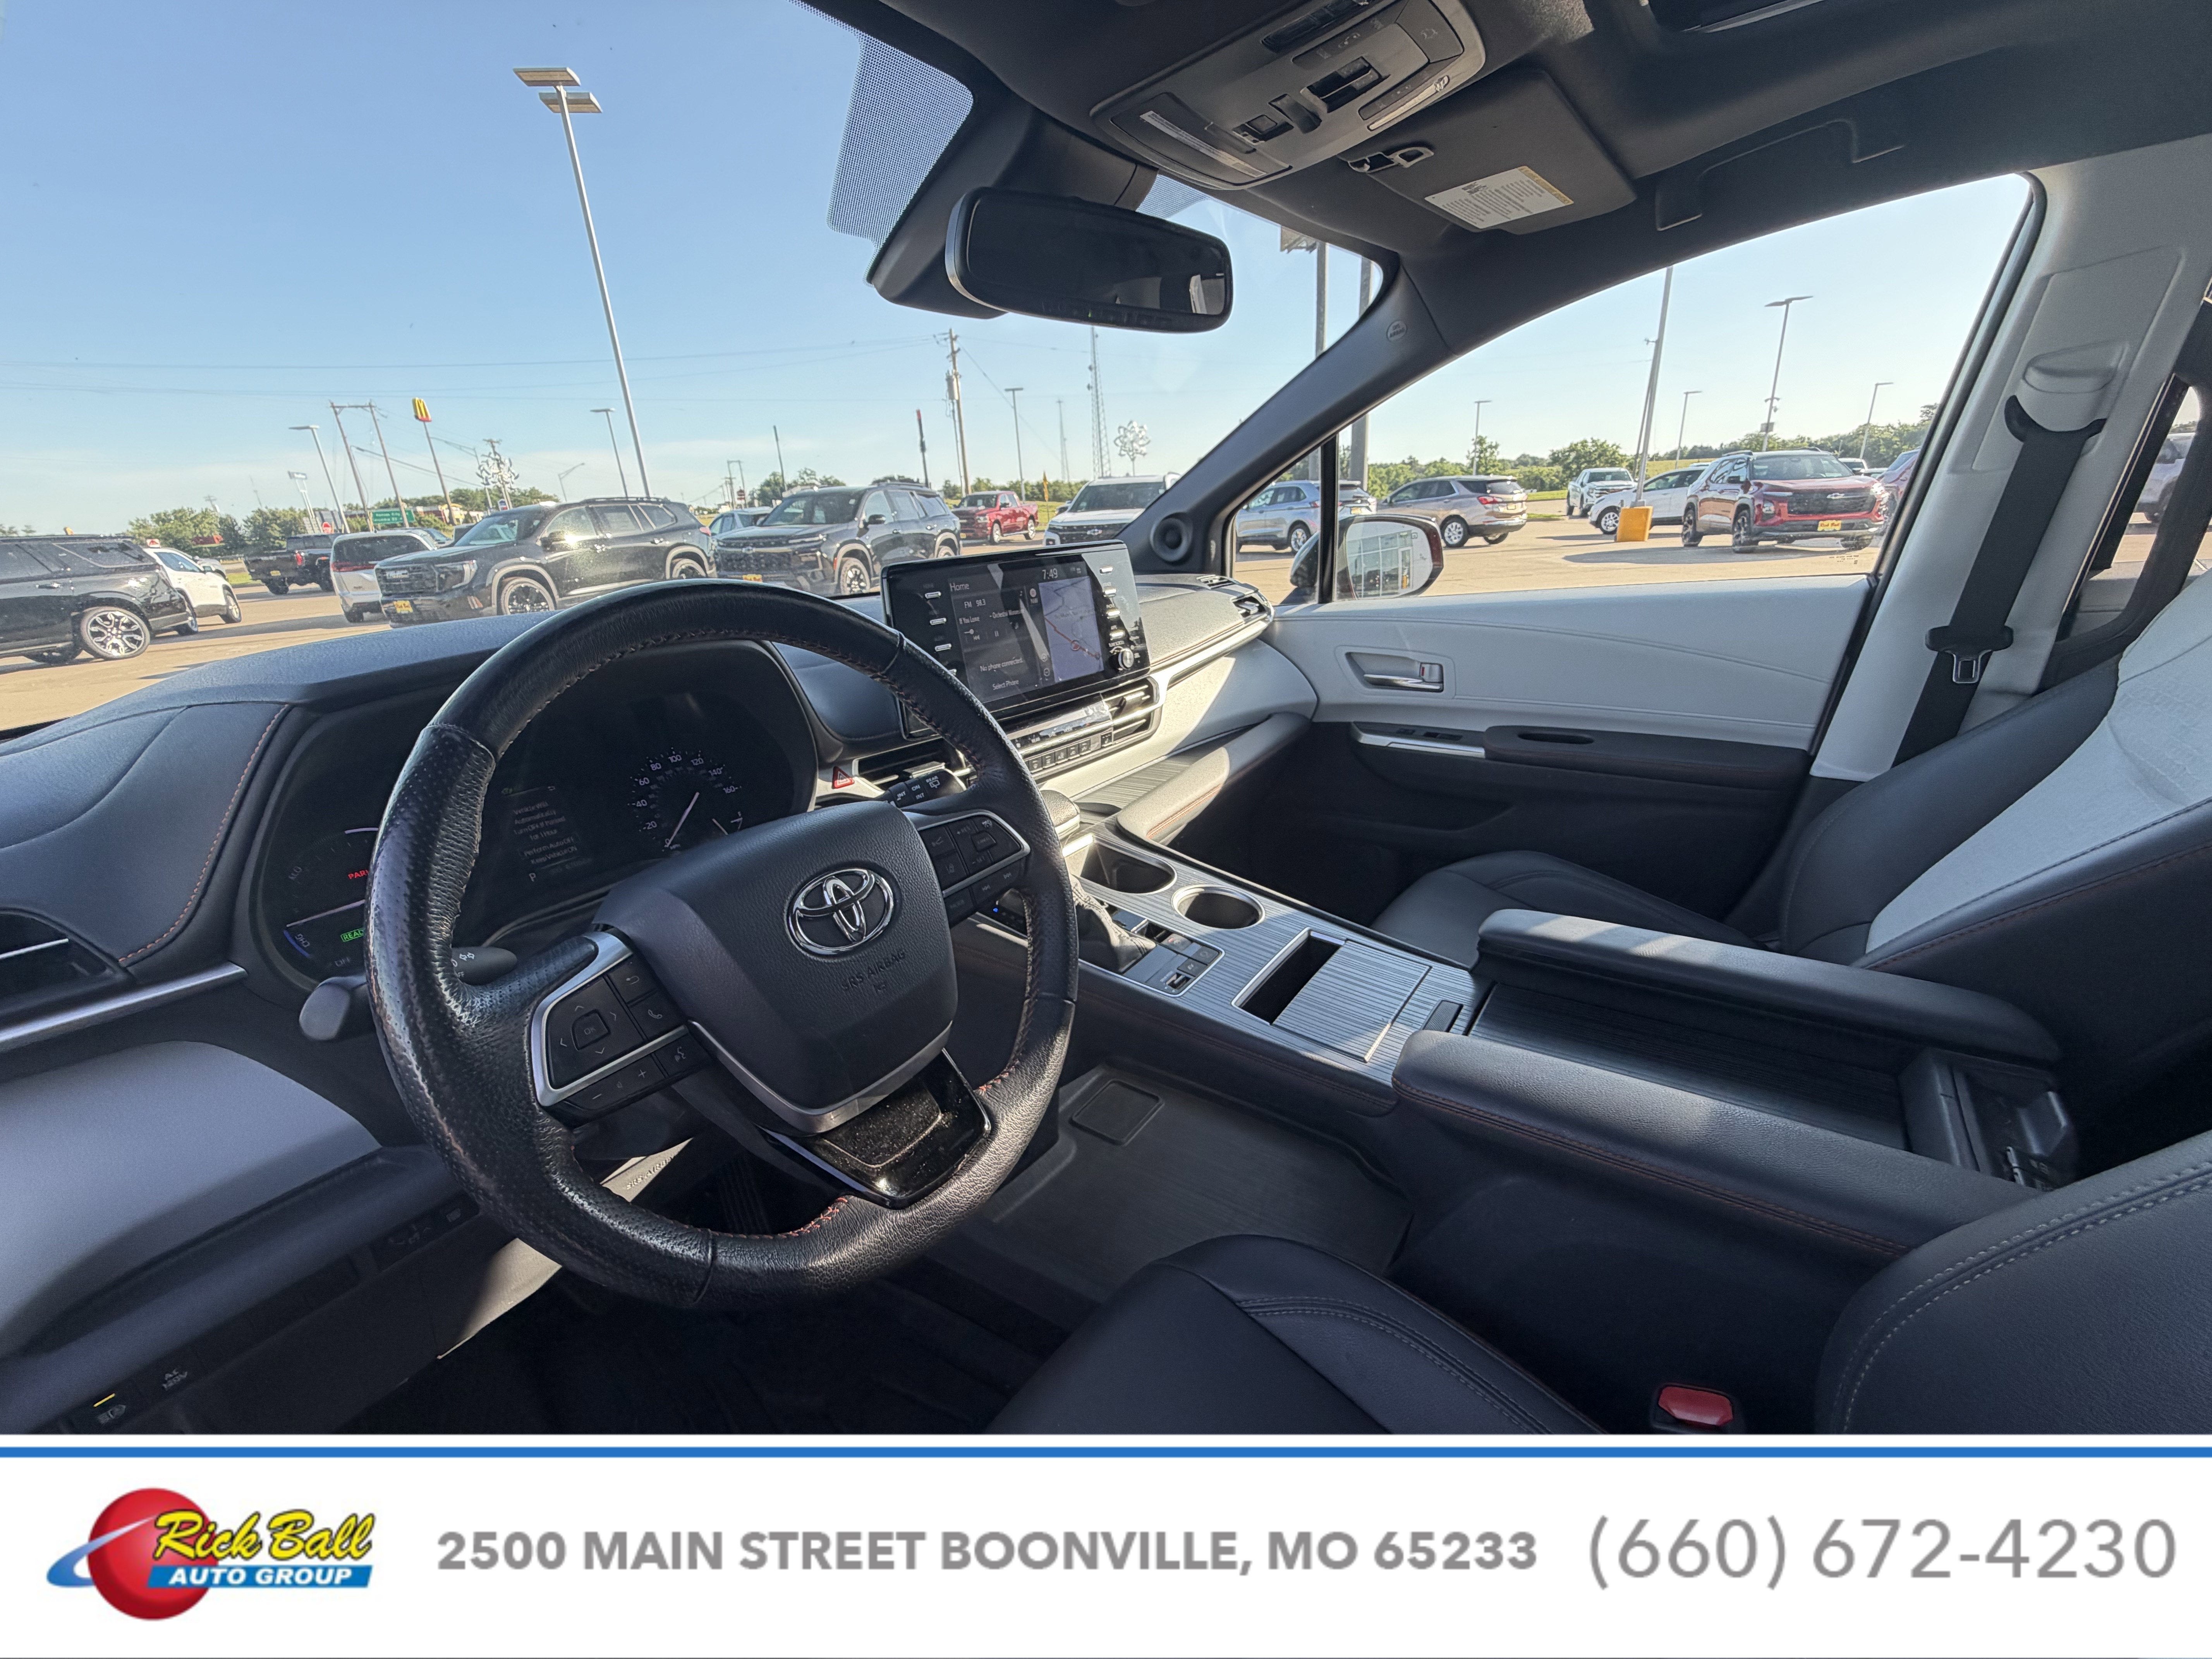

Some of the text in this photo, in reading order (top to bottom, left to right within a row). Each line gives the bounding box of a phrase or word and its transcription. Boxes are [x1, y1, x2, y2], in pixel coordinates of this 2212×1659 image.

[1042, 568, 1058, 580] 7:49
[950, 582, 969, 592] Home
[988, 663, 1001, 671] phone
[993, 682, 1006, 690] Select
[668, 754, 682, 763] 100
[691, 757, 704, 766] 120
[650, 763, 661, 771] 80
[709, 768, 722, 776] 140
[639, 777, 650, 785] 60
[723, 785, 735, 794] 160
[646, 821, 657, 830] 20
[529, 872, 536, 882] P
[295, 933, 310, 948] CHG
